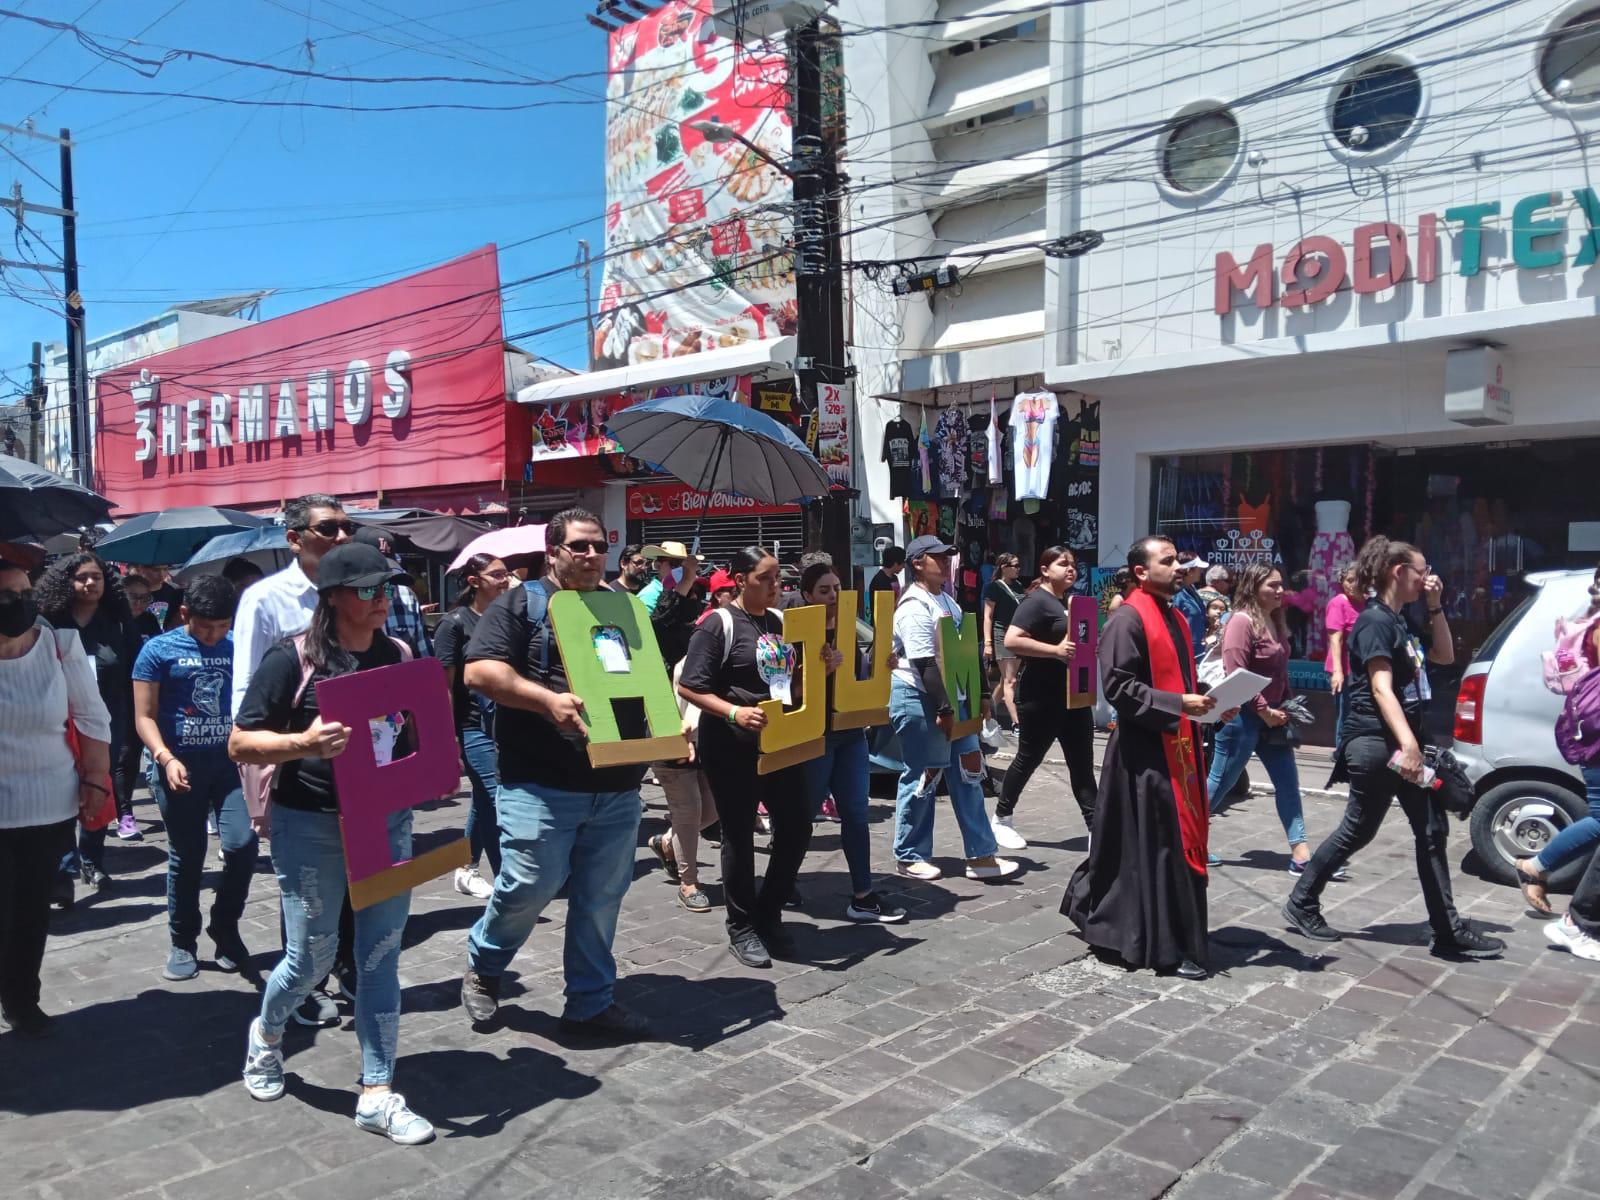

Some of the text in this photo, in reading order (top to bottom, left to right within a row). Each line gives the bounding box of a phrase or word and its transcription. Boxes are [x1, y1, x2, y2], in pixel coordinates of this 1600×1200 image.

[135, 349, 413, 462] 3 HERMANOS
[1068, 481, 1092, 498] AC/DC
[1207, 551, 1283, 565] PRIMAVERA
[178, 657, 231, 667] CAUTION
[184, 717, 202, 726] YOU
[204, 717, 221, 725] ARE
